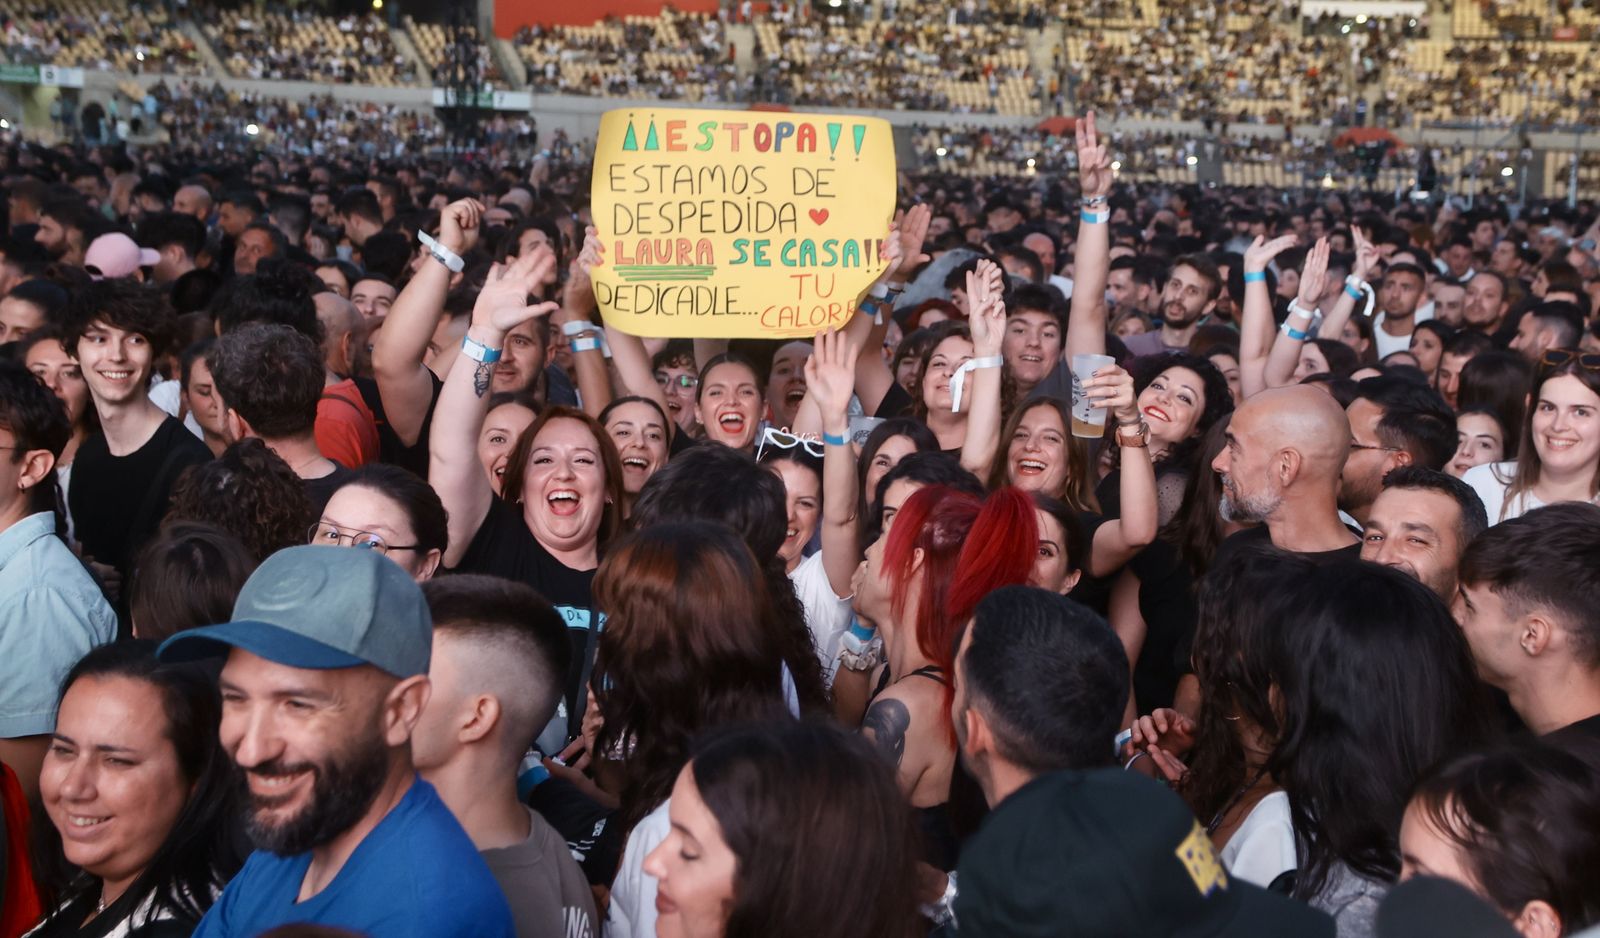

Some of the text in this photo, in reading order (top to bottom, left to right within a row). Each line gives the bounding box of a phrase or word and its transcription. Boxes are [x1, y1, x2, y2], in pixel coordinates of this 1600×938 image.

[609, 163, 836, 198] ESTAMOS DE
[613, 196, 797, 236] DESPEDIDA
[614, 237, 884, 273] LAURA SE CASA!!
[596, 281, 758, 316] DEDICADLE...
[789, 272, 835, 300] TU
